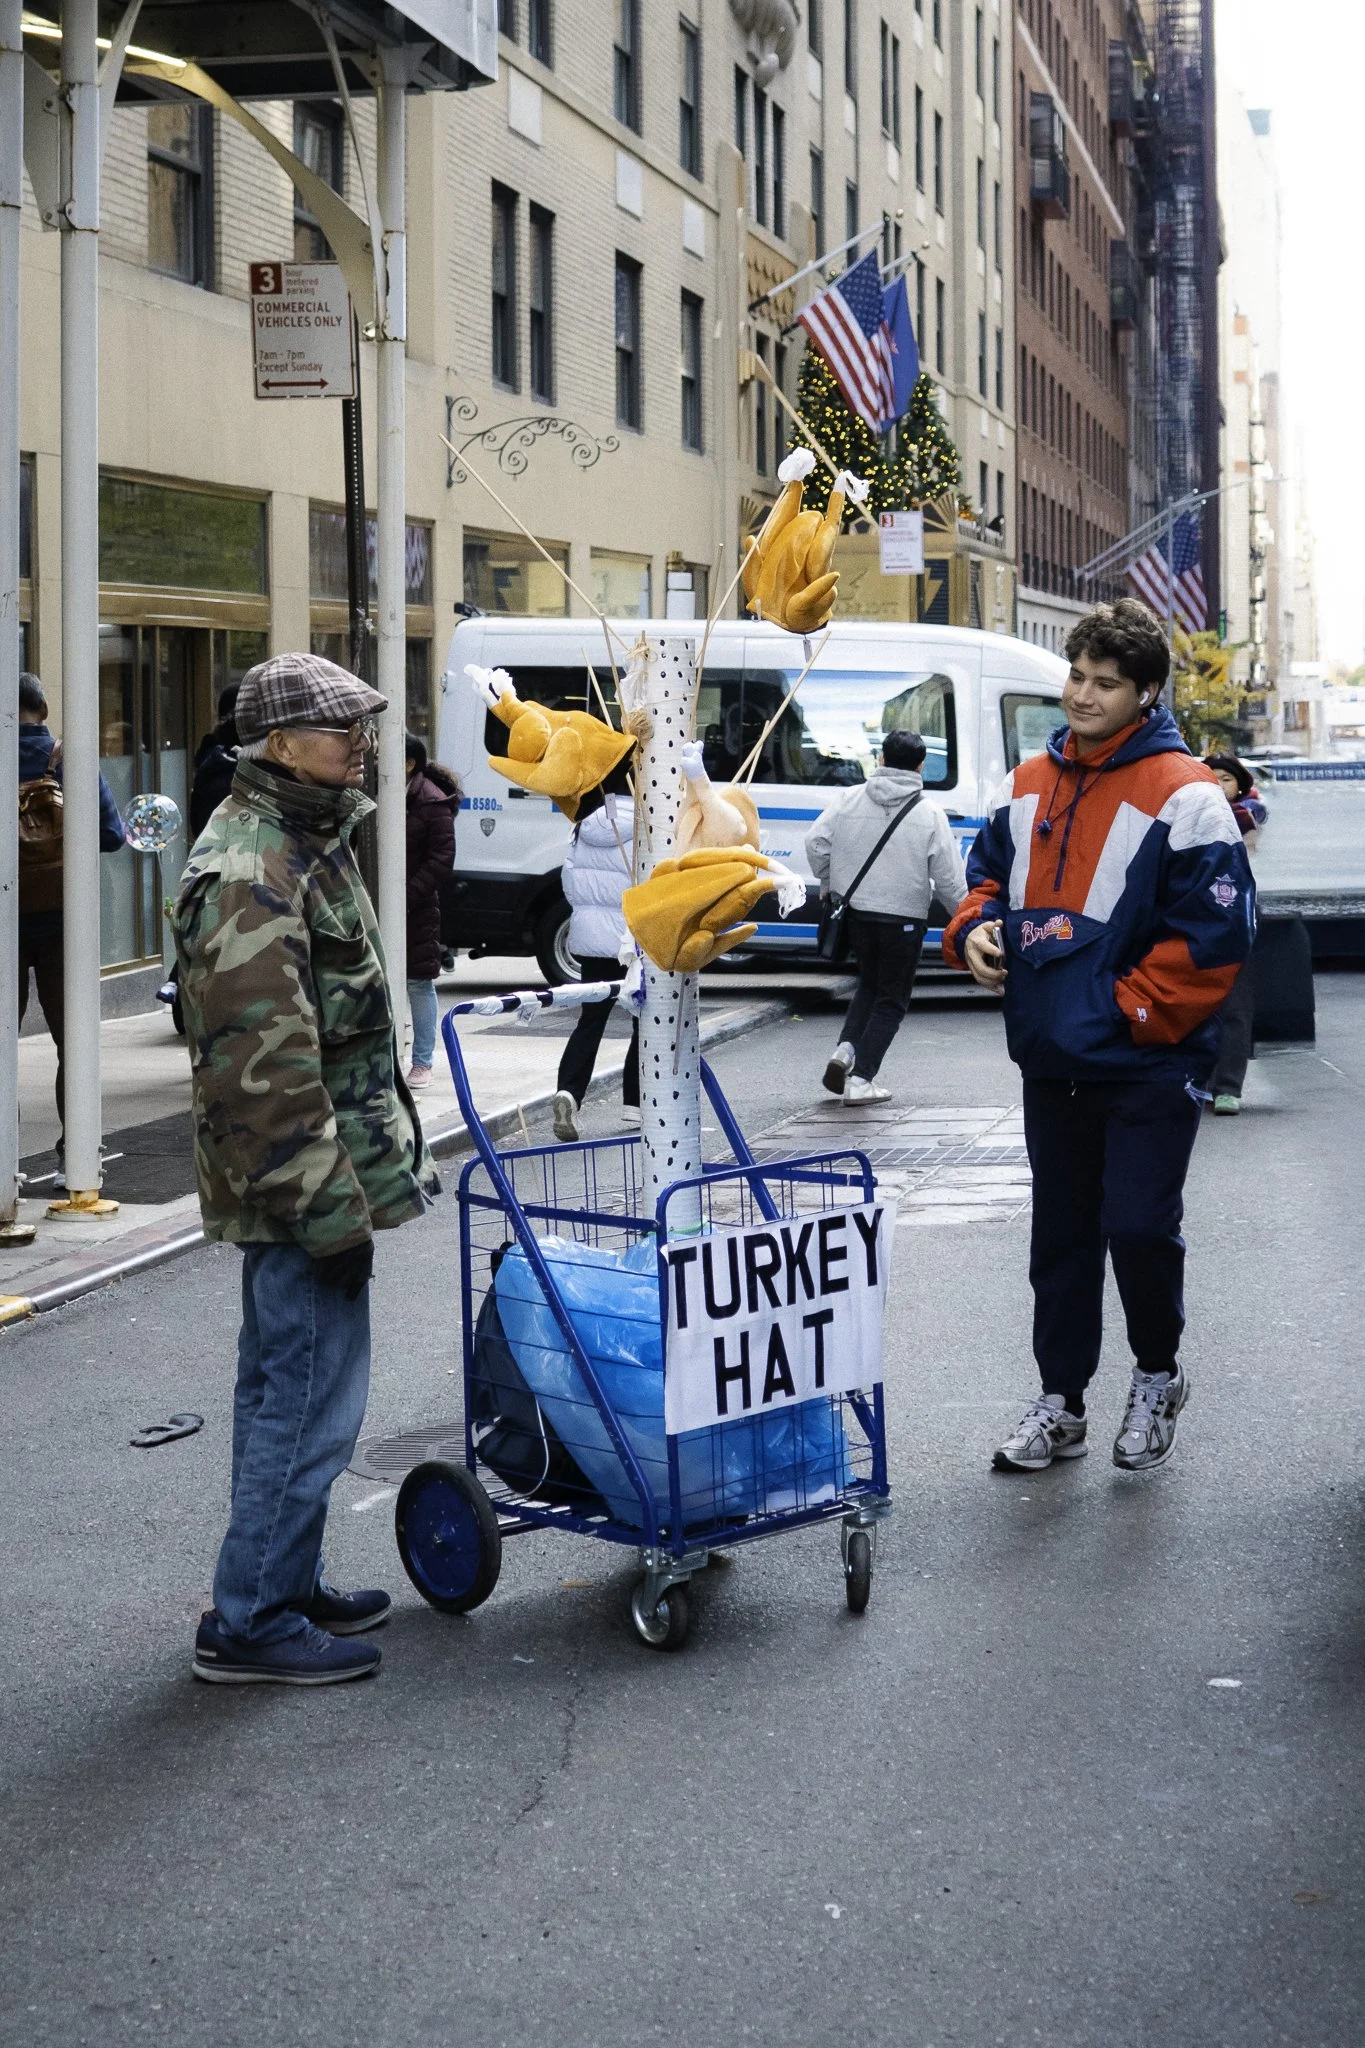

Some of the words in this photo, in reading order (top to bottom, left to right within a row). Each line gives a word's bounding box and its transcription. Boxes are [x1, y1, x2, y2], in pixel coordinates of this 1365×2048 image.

[260, 266, 275, 293] 3
[286, 287, 316, 296] parking
[256, 301, 331, 314] COMMERCIAL
[257, 316, 312, 329] VEHICLES
[314, 316, 343, 328] ONLY
[259, 362, 289, 374] Except
[291, 361, 324, 374] Sunday
[472, 797, 497, 811] 8580
[668, 1207, 885, 1331] TURKEY
[713, 1307, 835, 1417] HAT
